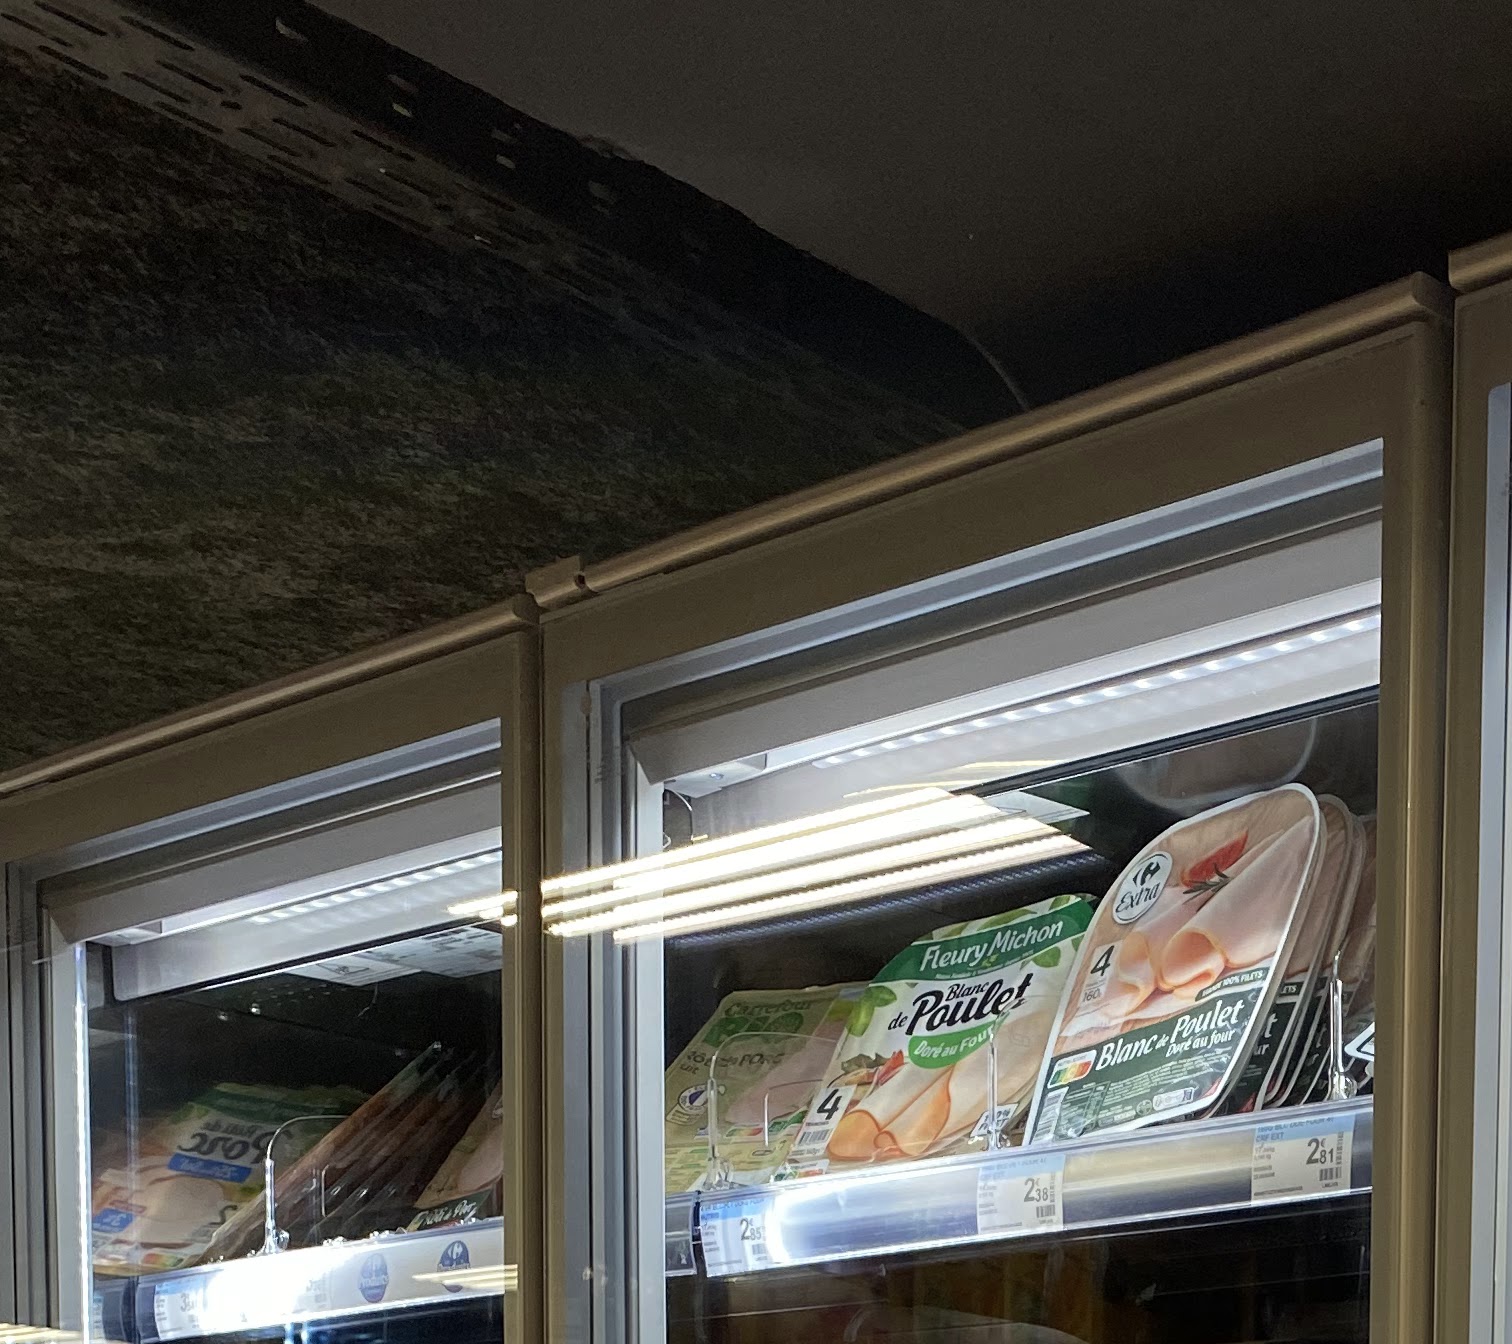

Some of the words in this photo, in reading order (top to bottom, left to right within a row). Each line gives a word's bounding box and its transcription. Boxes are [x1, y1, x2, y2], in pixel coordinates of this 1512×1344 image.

[1117, 879, 1163, 914] Extra
[919, 940, 991, 971] Fleury
[992, 921, 1063, 954] Michon
[905, 973, 1034, 1036] Poulet
[947, 981, 988, 997] Blanc
[1096, 1036, 1155, 1070] Blanc
[1156, 1036, 1169, 1049] de
[1173, 1001, 1244, 1042] Poulet
